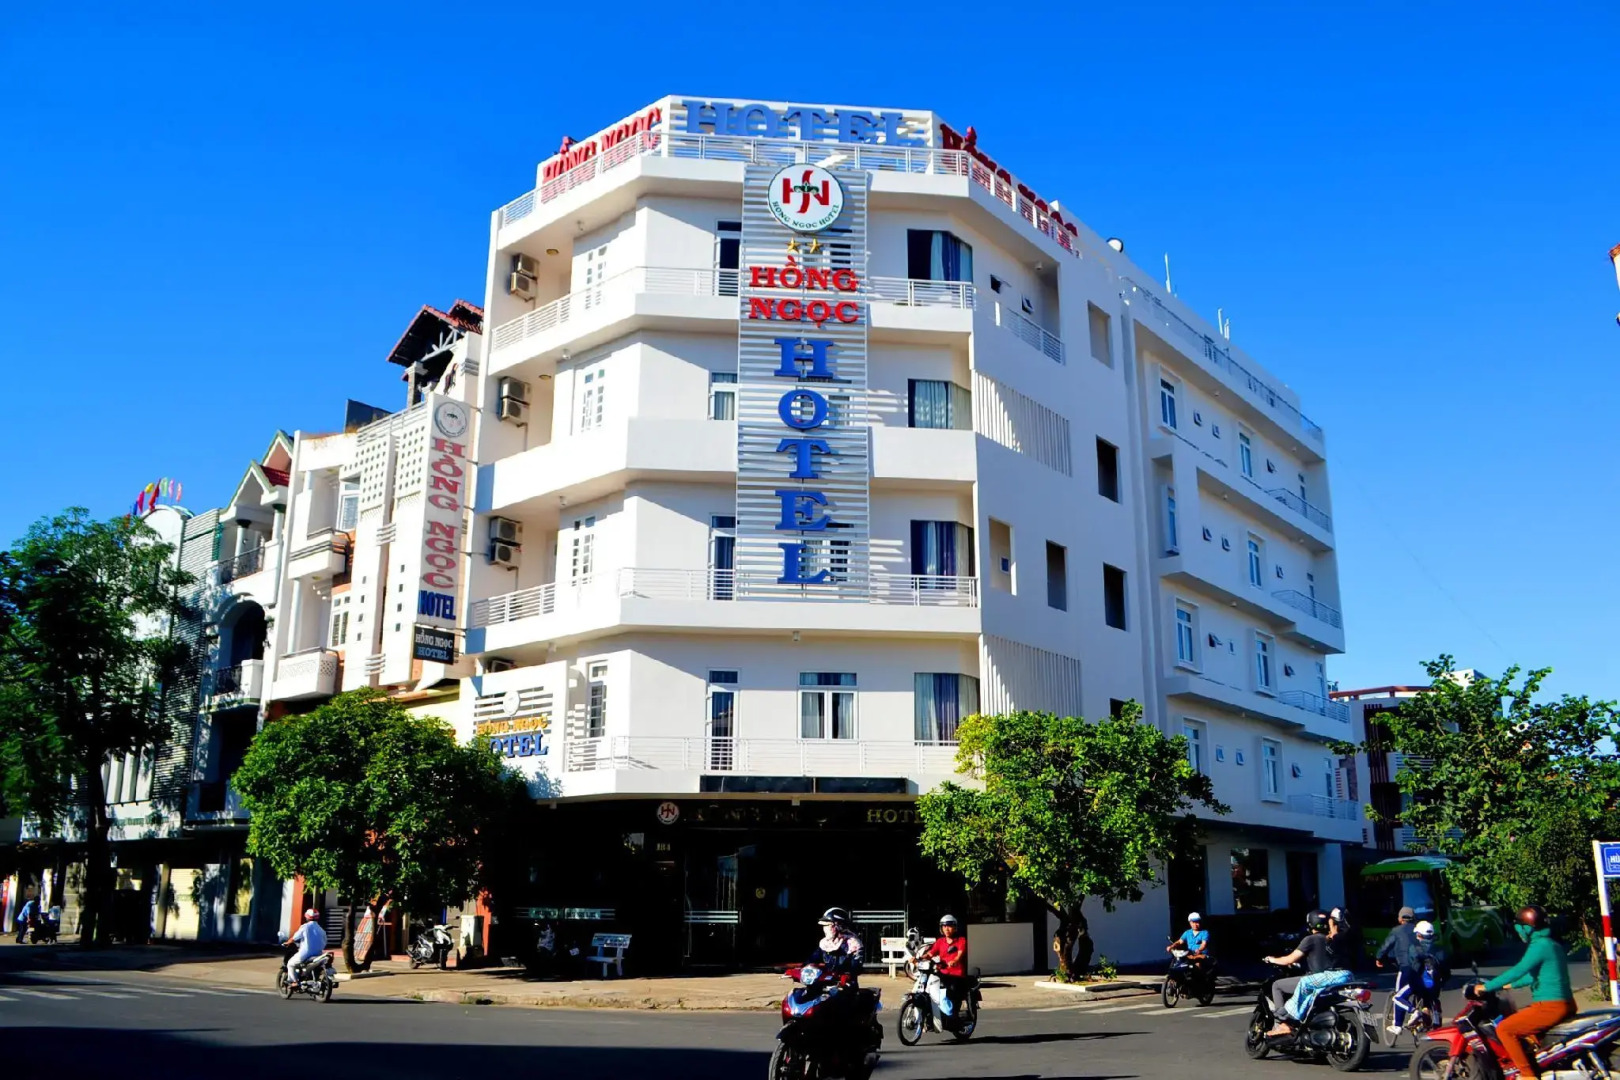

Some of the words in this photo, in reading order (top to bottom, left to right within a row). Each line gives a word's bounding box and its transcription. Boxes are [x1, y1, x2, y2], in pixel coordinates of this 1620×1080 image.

[682, 100, 926, 150] HOTEL
[749, 255, 859, 291] HỒNG
[749, 297, 860, 328] NGỌC
[774, 337, 833, 585] HOTEL
[418, 589, 456, 620] HOTEL
[417, 646, 450, 660] HOTEL
[489, 733, 549, 758] OTEL
